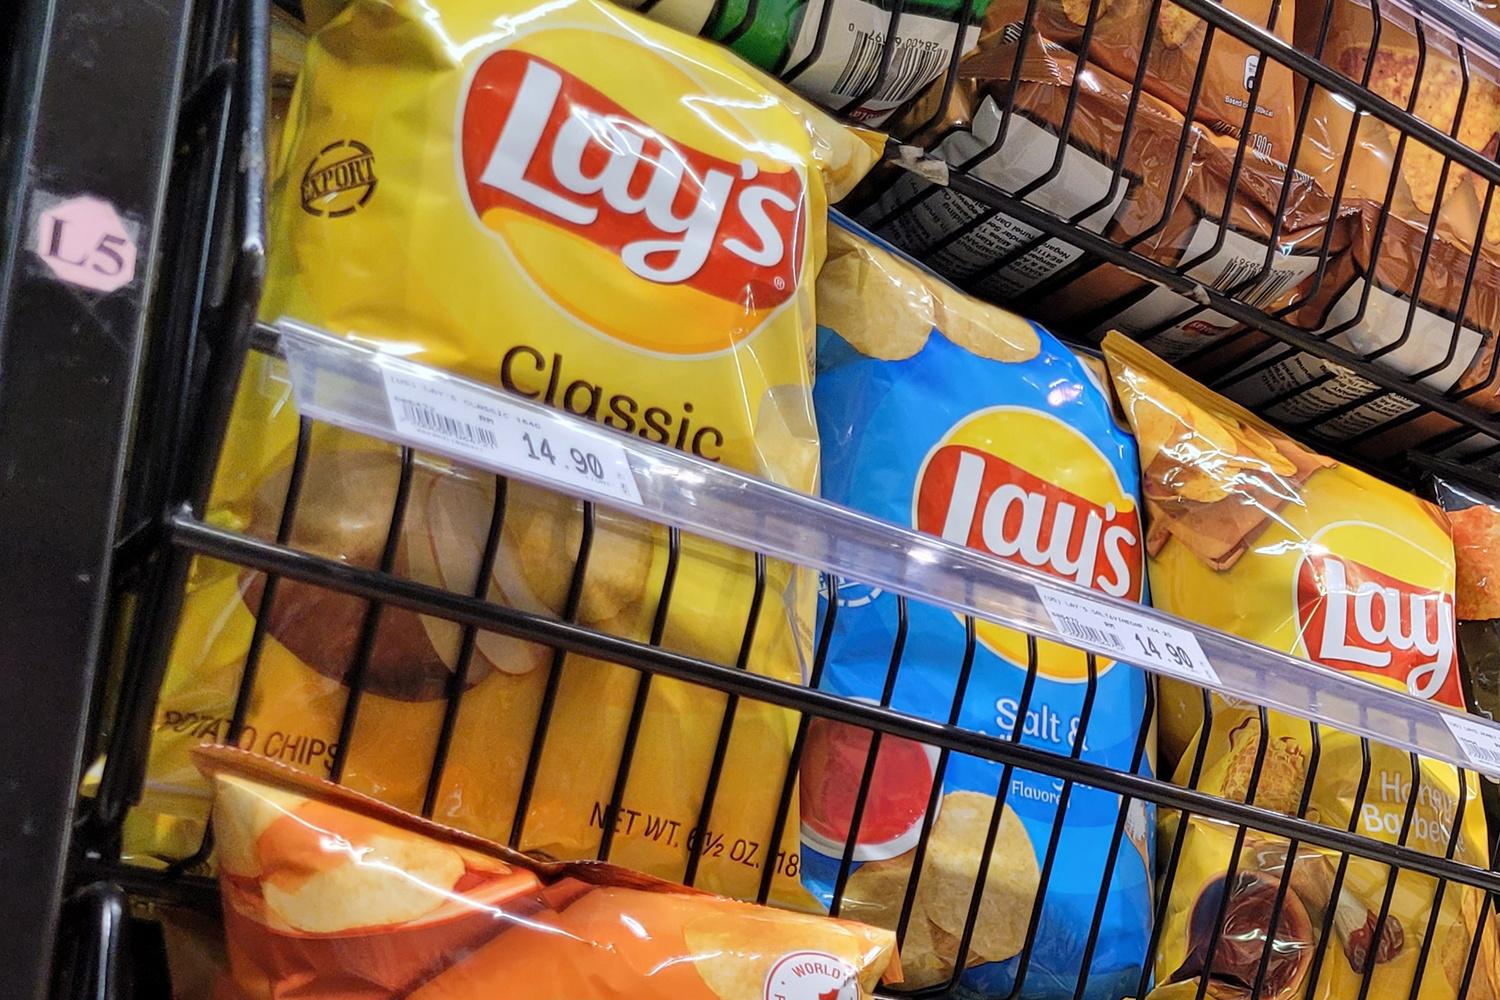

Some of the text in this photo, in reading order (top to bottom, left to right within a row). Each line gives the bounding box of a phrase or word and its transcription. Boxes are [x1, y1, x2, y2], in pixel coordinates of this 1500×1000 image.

[301, 157, 377, 202] EXPORT
[480, 57, 797, 284] Lay's
[48, 217, 128, 276] L5
[501, 345, 724, 463] Classic
[521, 430, 606, 481] 14.90
[942, 451, 1137, 598] Lay's
[1134, 632, 1195, 669] 14.90
[158, 709, 259, 753] POTAO
[995, 697, 1061, 744] Salt
[1011, 780, 1072, 810] Flavore
[643, 815, 681, 848] WT.
[729, 838, 760, 869] OZ.
